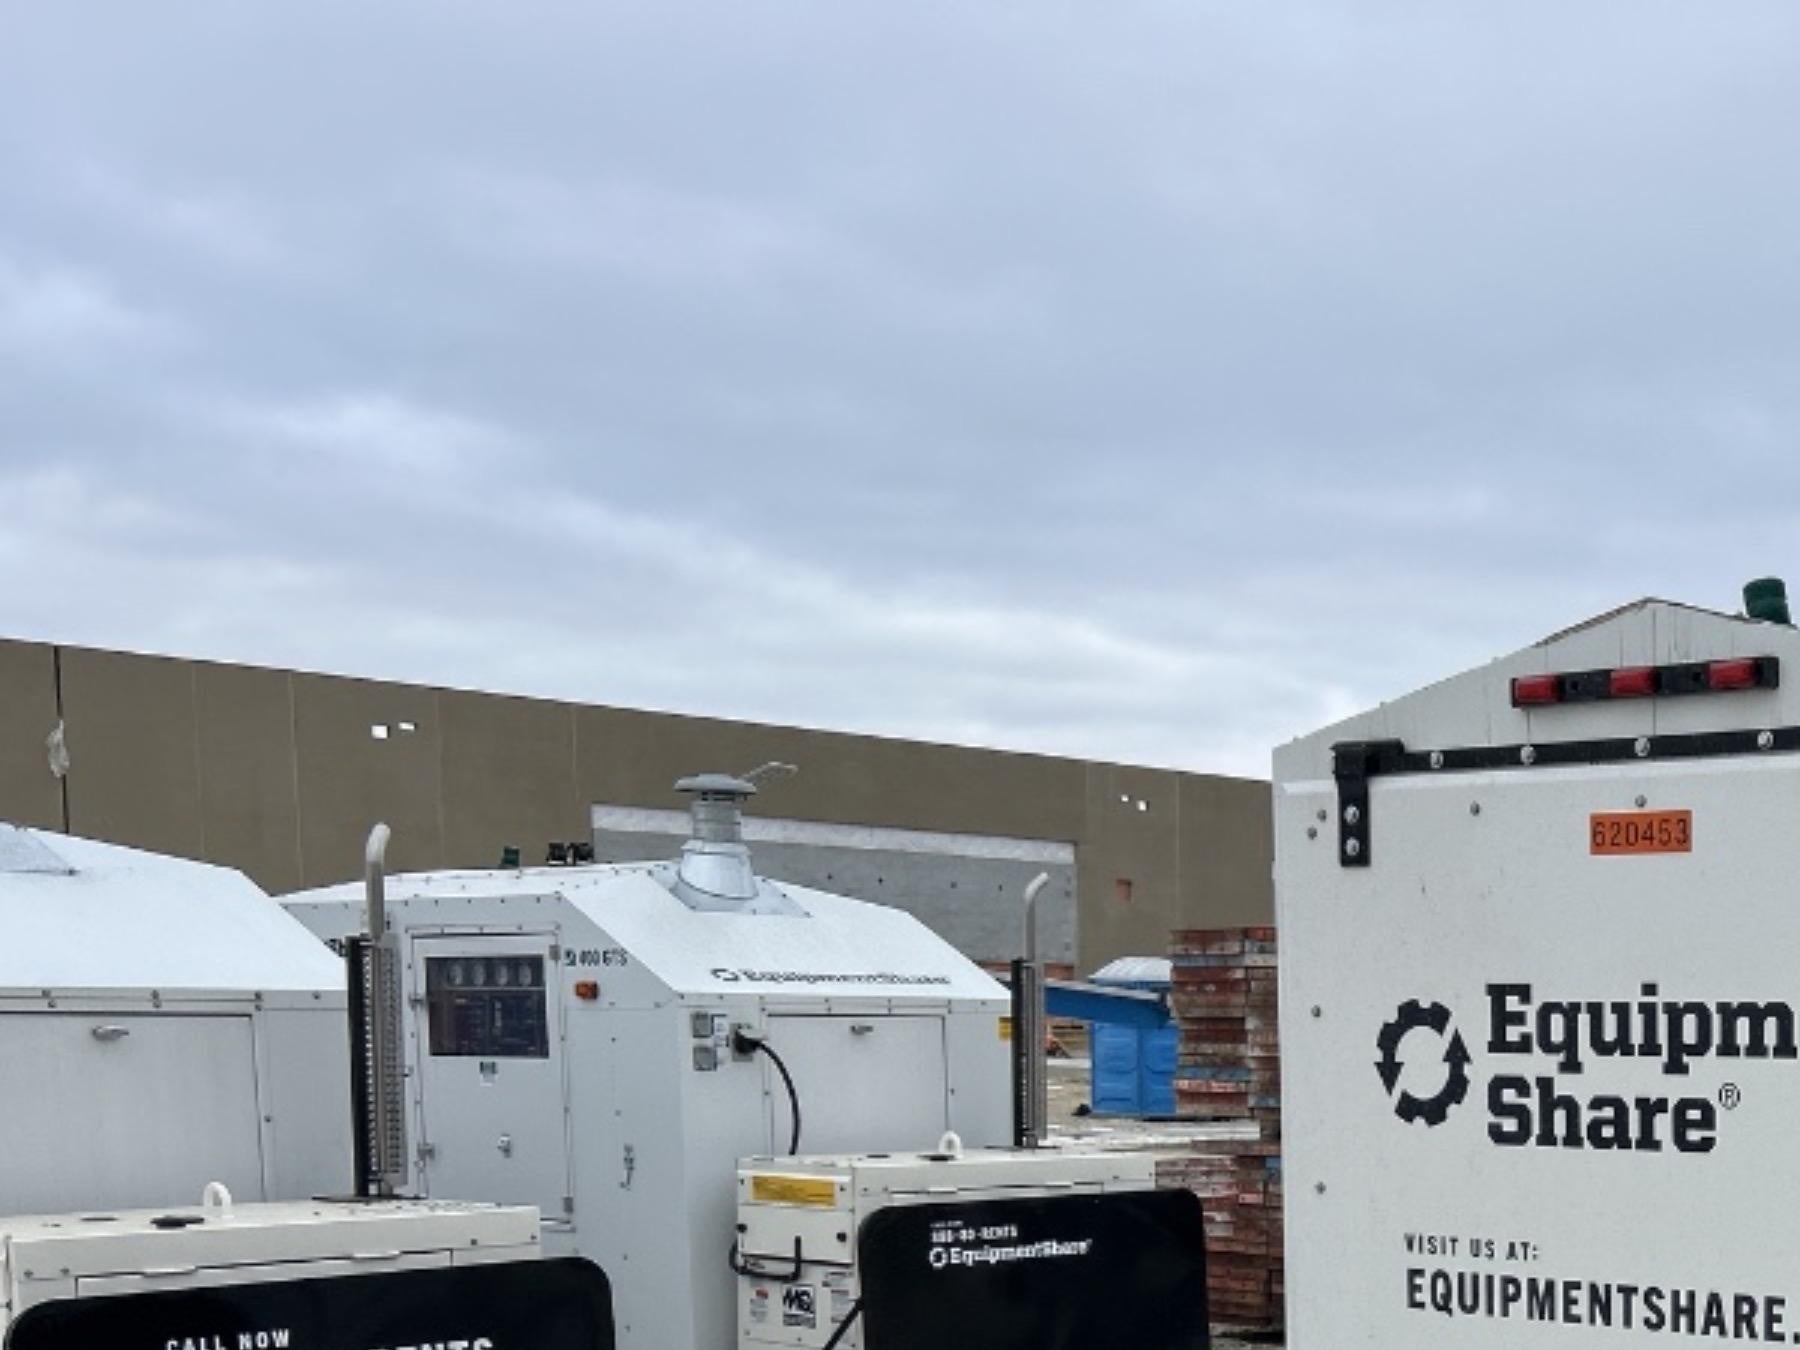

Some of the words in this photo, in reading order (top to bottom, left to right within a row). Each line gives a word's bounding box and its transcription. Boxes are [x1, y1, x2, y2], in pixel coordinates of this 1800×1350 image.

[1592, 818, 1689, 848] 620453
[1404, 1232, 1459, 1257] VISIT
[1470, 1238, 1496, 1259] US
[1506, 1240, 1540, 1262] AT:
